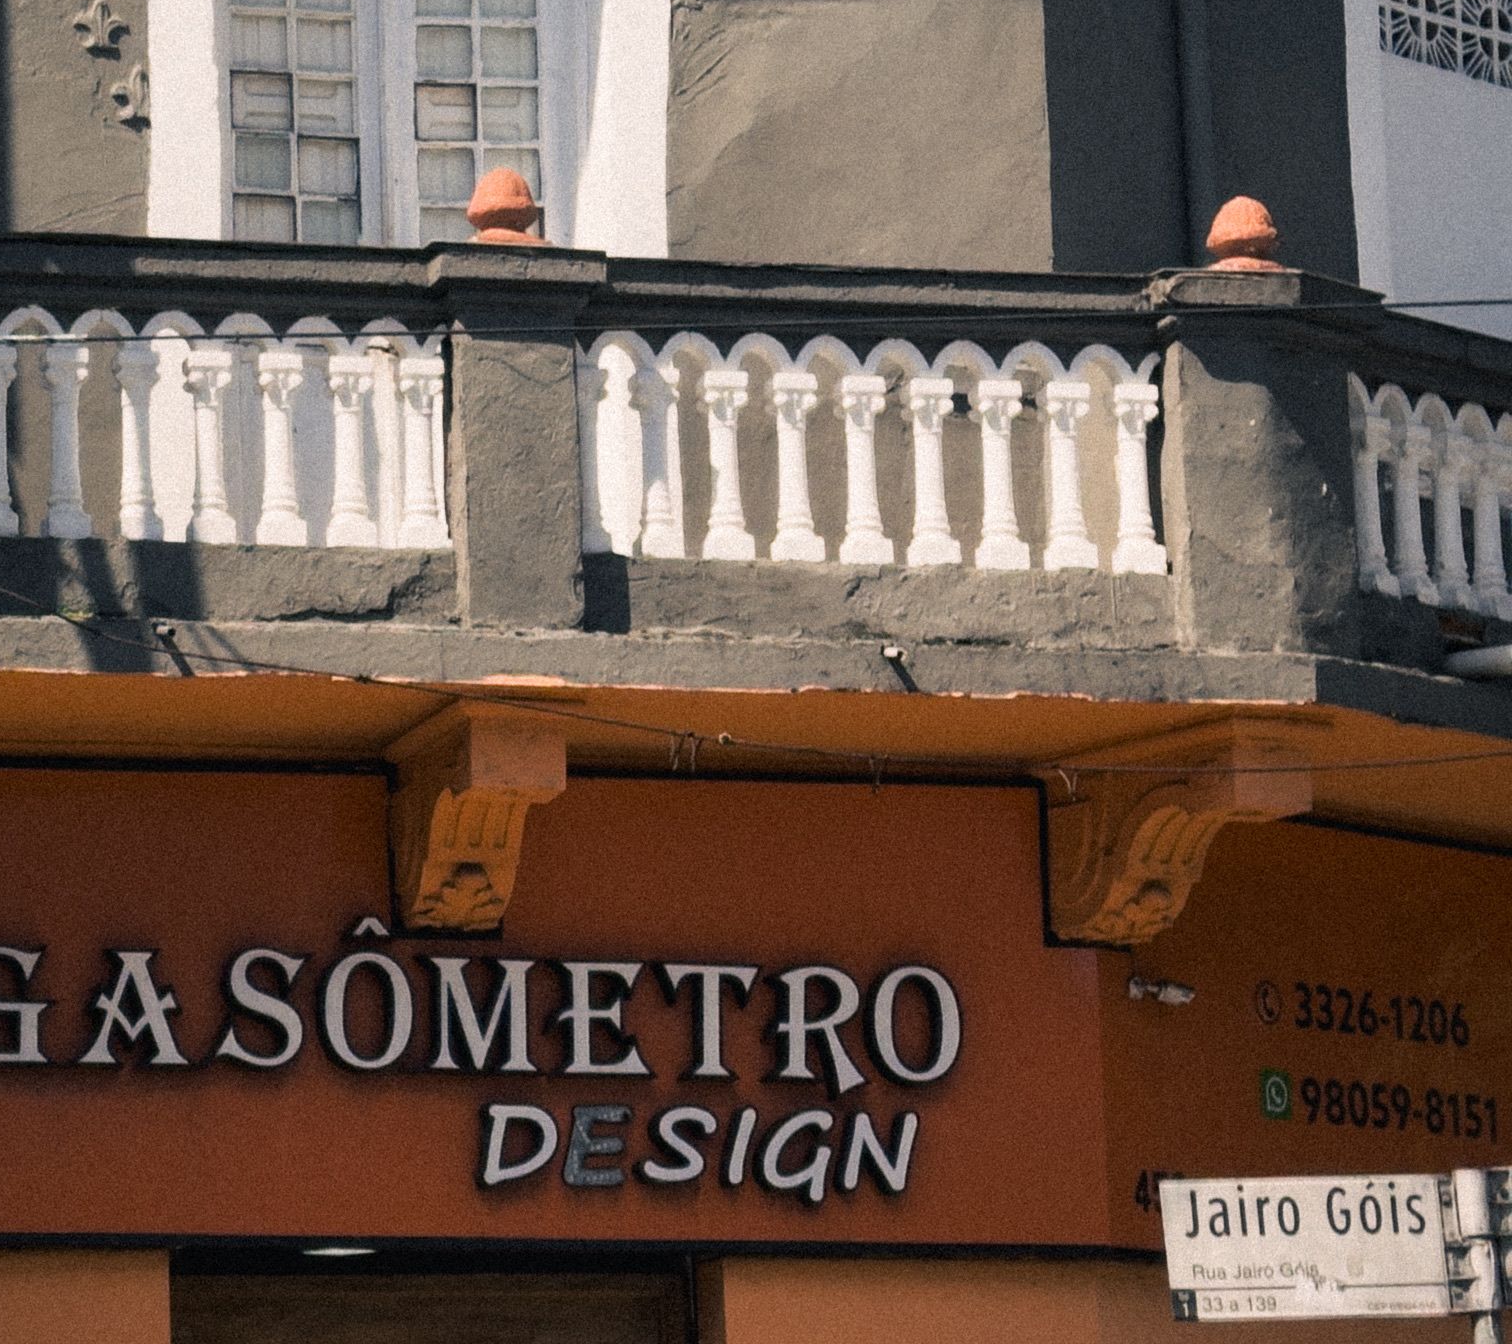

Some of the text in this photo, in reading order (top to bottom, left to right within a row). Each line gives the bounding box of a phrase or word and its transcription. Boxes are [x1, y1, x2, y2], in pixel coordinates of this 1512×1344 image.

[1294, 981, 1470, 1047] 3326-1206
[1300, 1077, 1498, 1144] 98059-8151
[479, 1102, 920, 1203] DESIGN
[1185, 1184, 1300, 1238] Jairo
[1325, 1182, 1426, 1236] Góis
[1192, 1264, 1226, 1281] Rua
[1233, 1263, 1274, 1280] Jairo
[1202, 1295, 1277, 1312] 33 a 139
